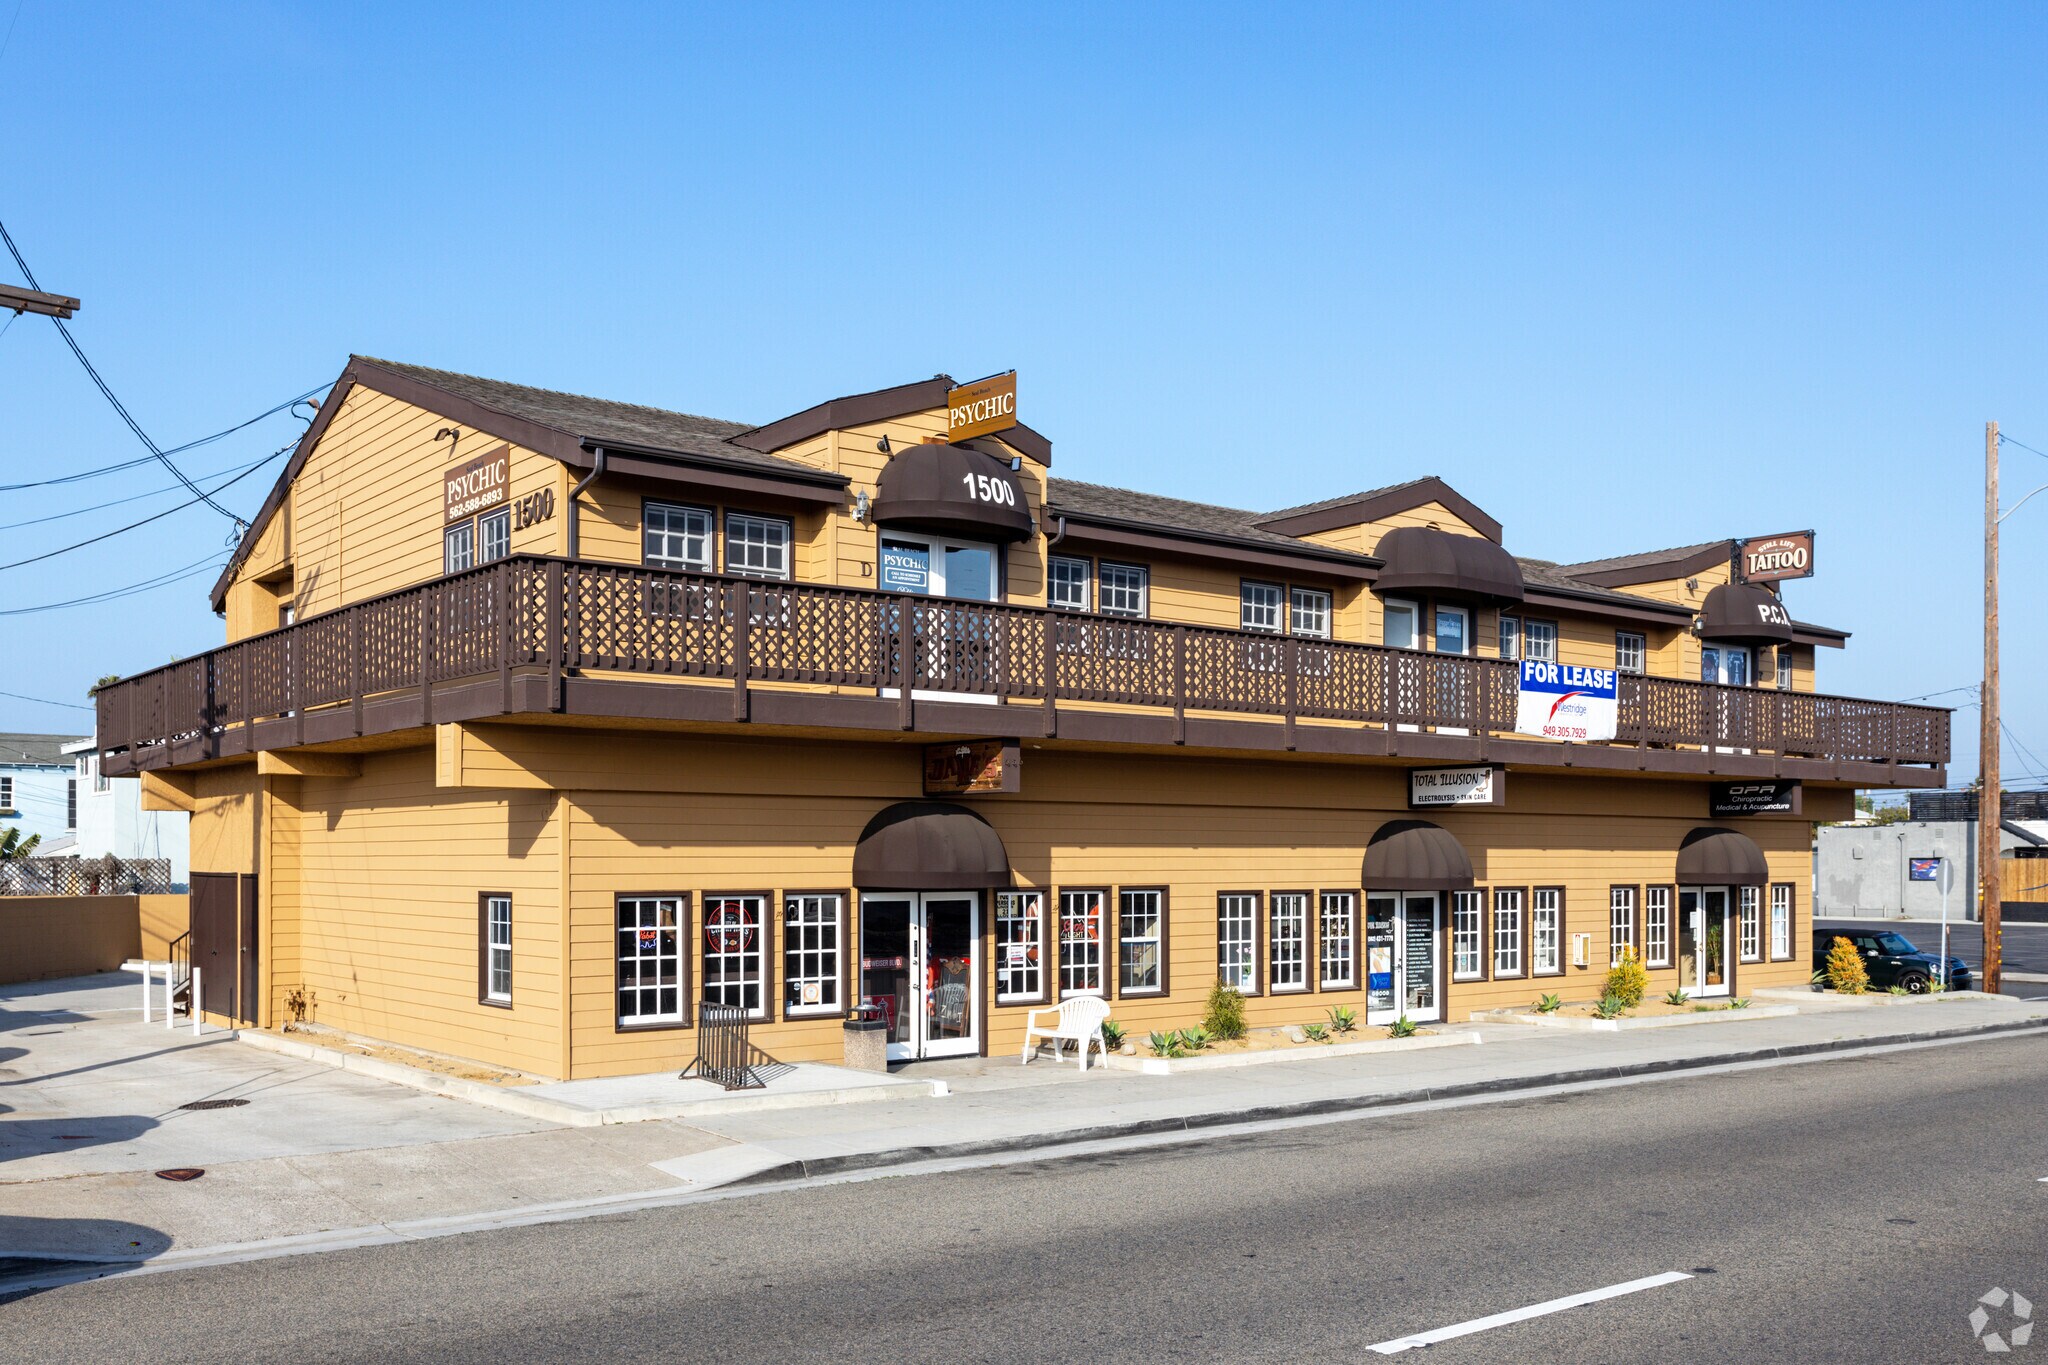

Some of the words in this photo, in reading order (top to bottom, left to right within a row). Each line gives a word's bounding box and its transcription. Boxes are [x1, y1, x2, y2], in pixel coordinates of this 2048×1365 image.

[950, 392, 1013, 429] PSYCHIC
[447, 459, 505, 504] PSYCHIC
[963, 472, 1015, 506] 1500
[449, 488, 503, 519] 562-588-6893
[514, 488, 554, 531] 1500
[1758, 541, 1778, 553] STILL
[1780, 540, 1796, 549] LIFE
[884, 554, 928, 570] PSYCHIC
[1748, 547, 1808, 574] TATTOO
[861, 562, 873, 577] D
[1525, 662, 1559, 684] FOR
[1563, 666, 1613, 689] LEASE
[1556, 702, 1587, 716] Westridge
[1543, 725, 1587, 738] 949.305.7929
[1414, 774, 1438, 787] TOTAL
[1440, 773, 1479, 786] ILLUSION
[1418, 794, 1455, 802] ELECTROLYSIS
[1732, 795, 1773, 803] Chiropractic
[1749, 803, 1790, 811] Acupuncture
